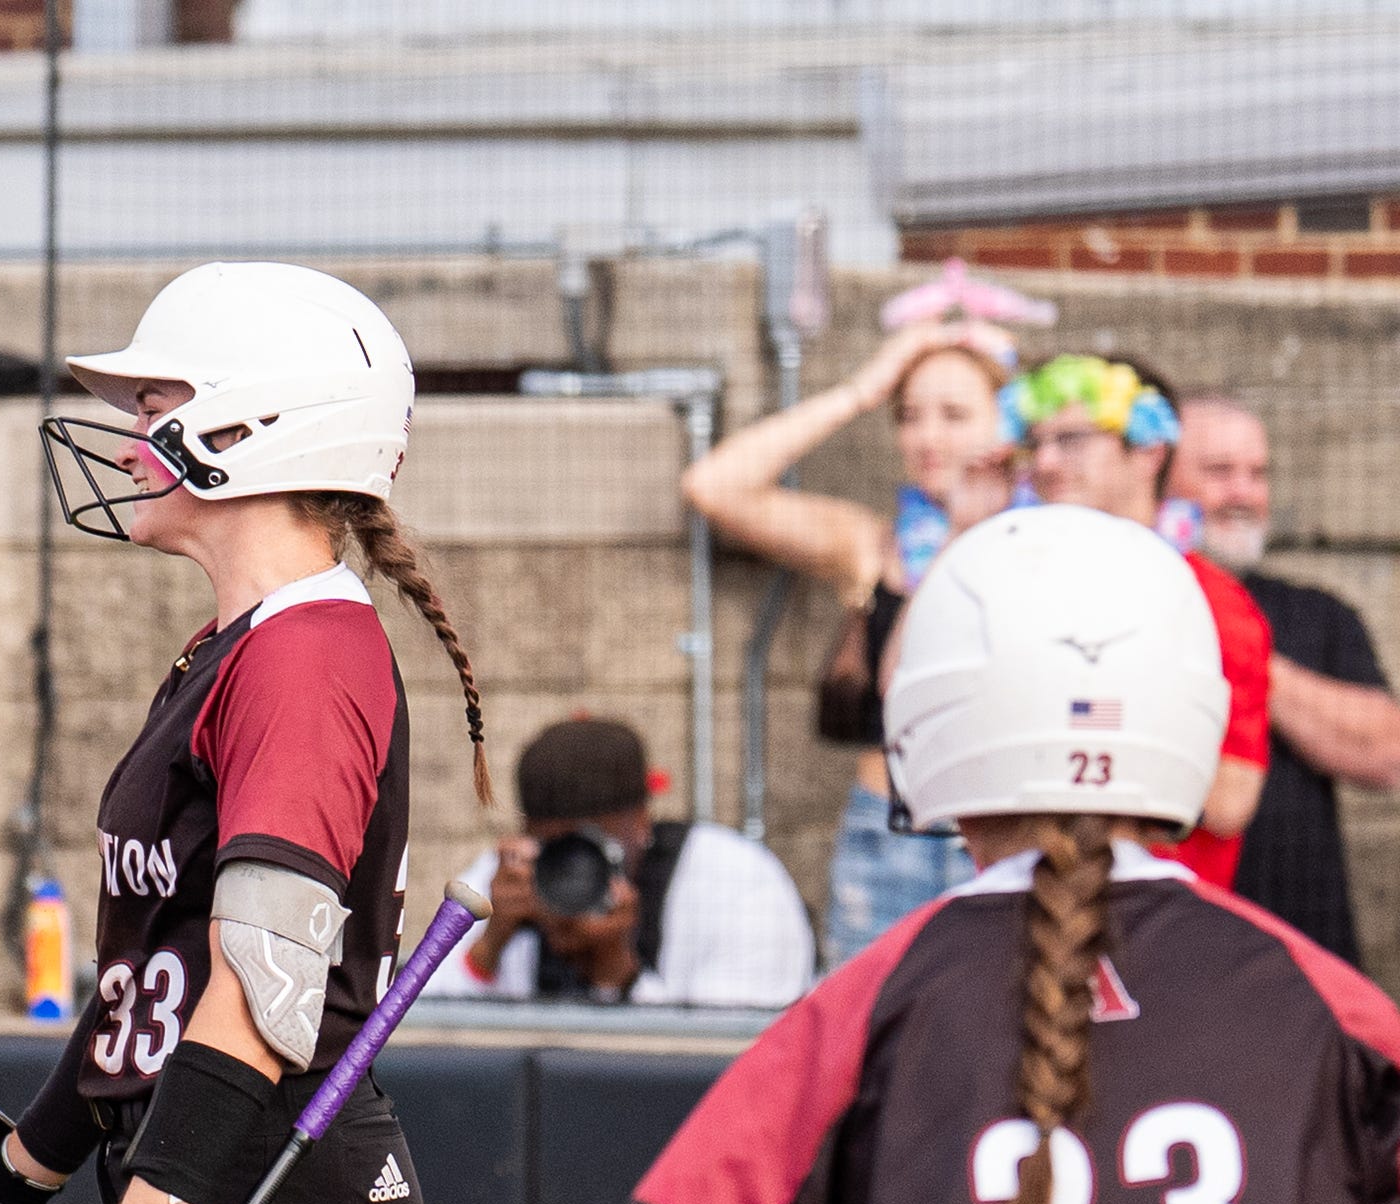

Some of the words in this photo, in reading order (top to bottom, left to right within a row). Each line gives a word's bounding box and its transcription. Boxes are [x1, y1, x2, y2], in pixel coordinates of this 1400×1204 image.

[1070, 752, 1111, 785] 23
[92, 948, 187, 1077] 33
[369, 1181, 410, 1202] adidas
